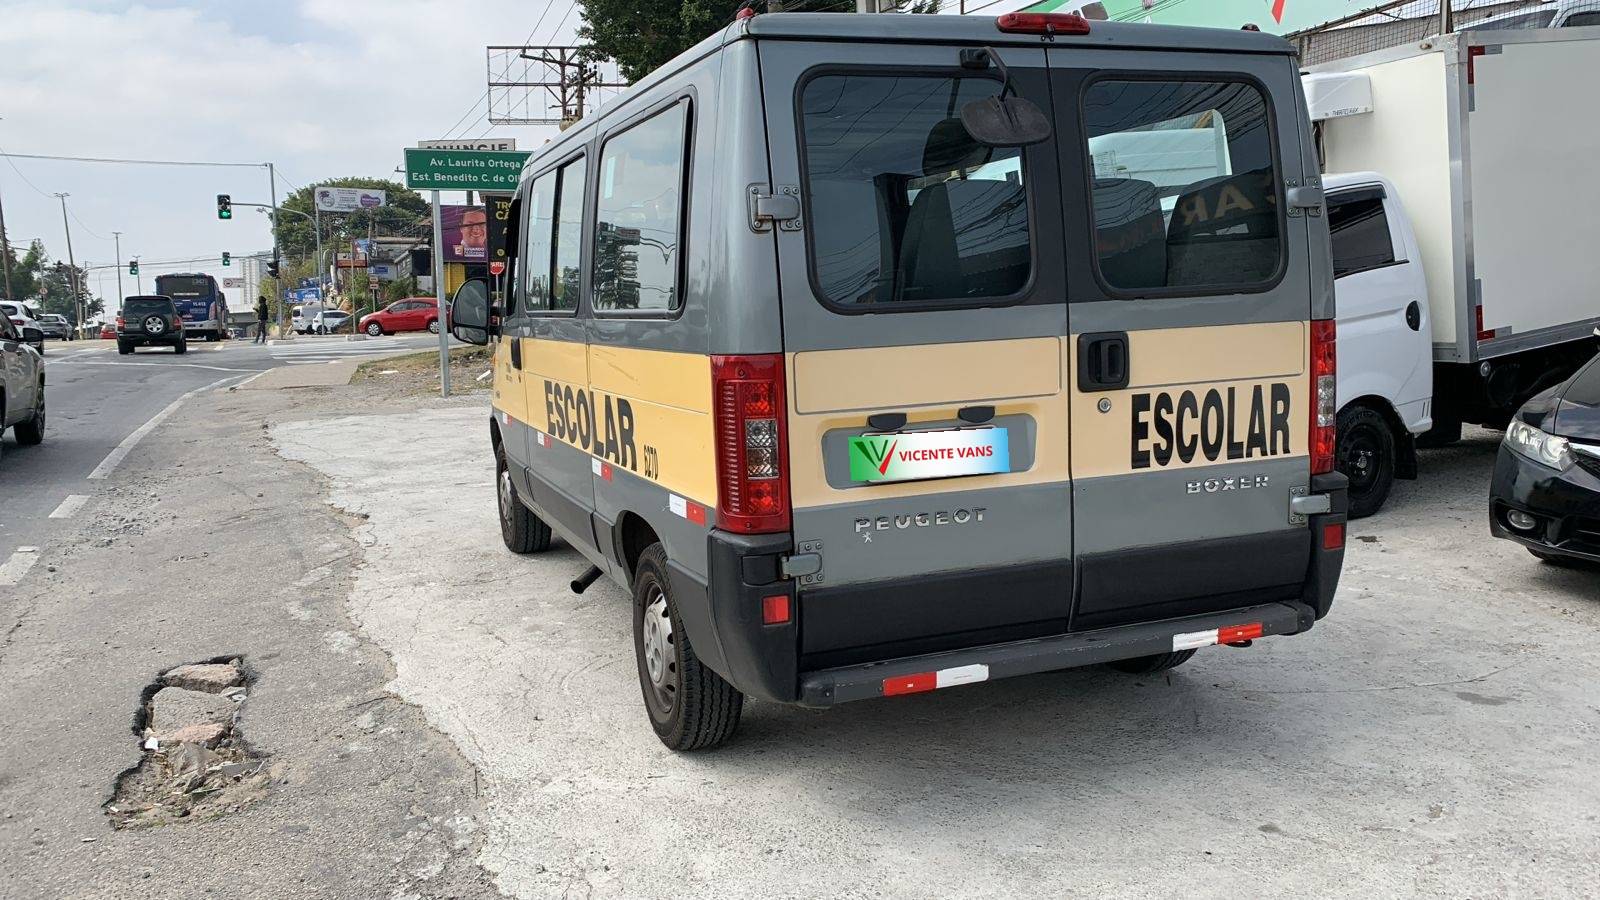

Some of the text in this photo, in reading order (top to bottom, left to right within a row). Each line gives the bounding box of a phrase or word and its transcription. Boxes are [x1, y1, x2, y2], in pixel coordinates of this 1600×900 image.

[430, 158, 521, 170] Av. Laurita Ortega
[412, 172, 431, 181] Est.
[434, 173, 478, 182] Benedito
[481, 174, 490, 182] C.
[493, 174, 505, 183] de
[544, 380, 637, 472] ESCOLAR
[1131, 383, 1291, 470] ESCOLAR
[643, 444, 659, 481] 6270
[1185, 473, 1269, 494] BOXER
[854, 507, 988, 533] PEUGEOT
